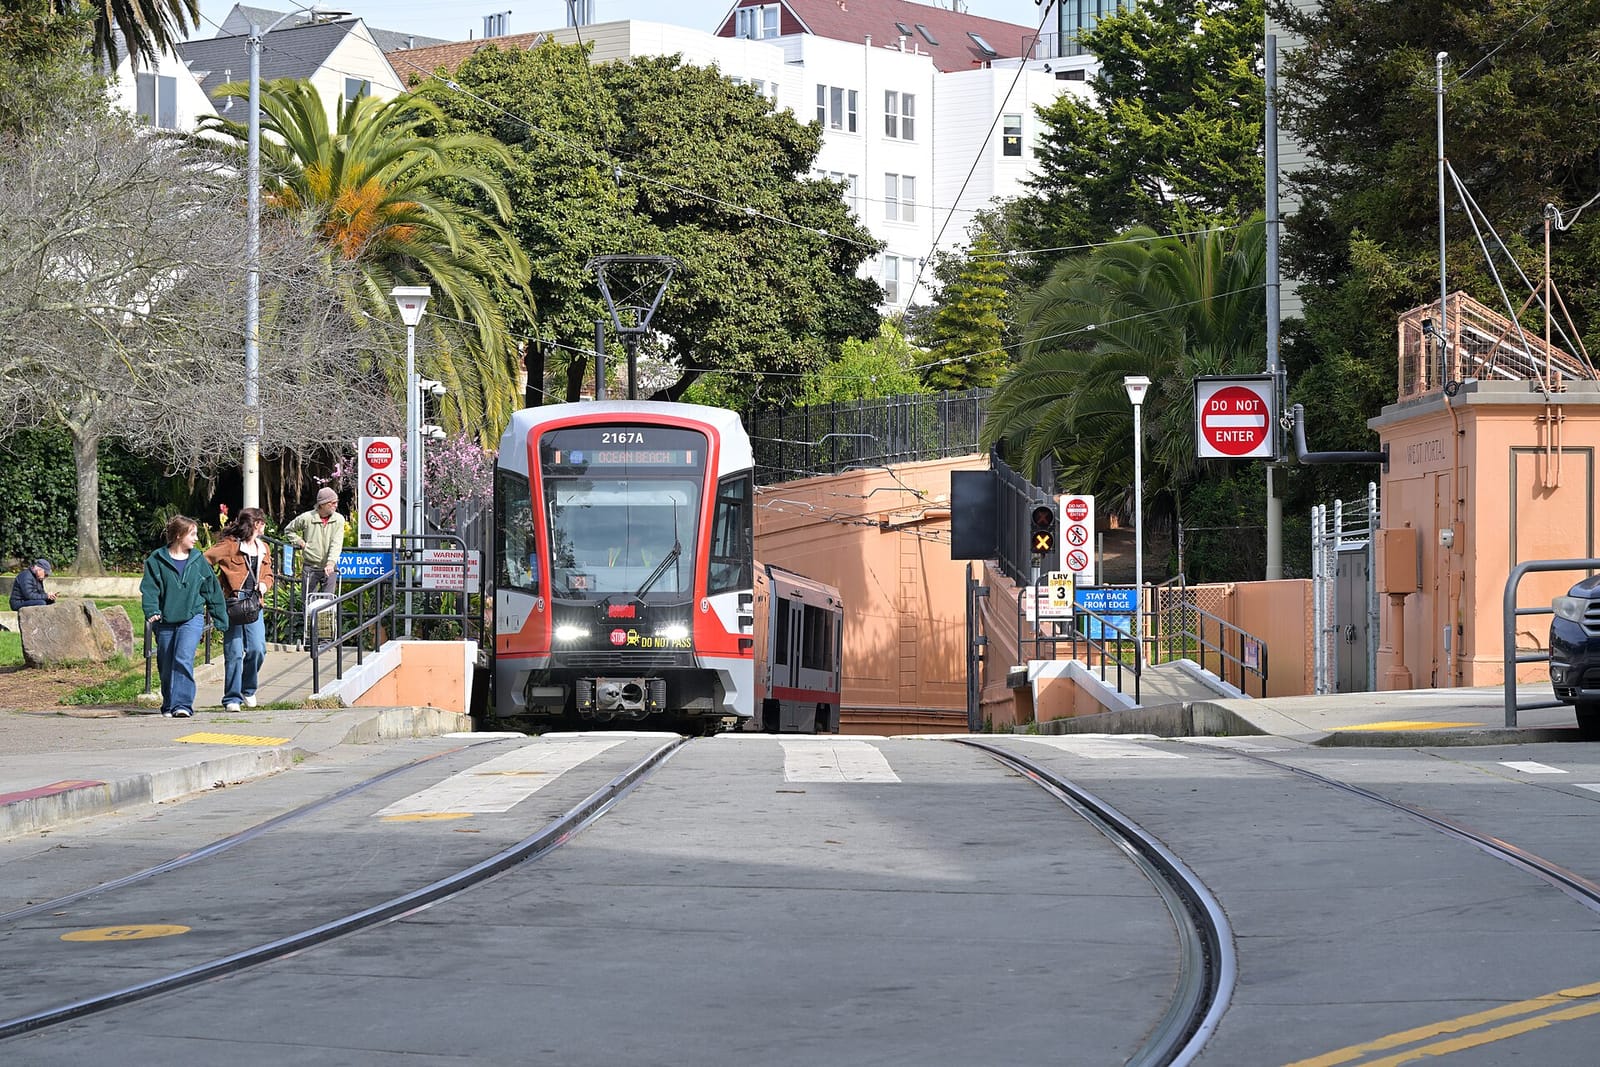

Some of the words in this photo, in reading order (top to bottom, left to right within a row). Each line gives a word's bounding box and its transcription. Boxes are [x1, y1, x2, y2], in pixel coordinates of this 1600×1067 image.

[1211, 400, 1227, 411] DO
[1236, 400, 1259, 411] NOT
[602, 432, 644, 444] 2167A
[1216, 430, 1254, 442] ENTER
[599, 451, 633, 463] OCEAN
[635, 451, 670, 463] BEACH
[356, 556, 382, 565] BACK
[359, 566, 385, 575] EDGE
[1056, 587, 1066, 599] 3
[611, 632, 626, 643] STOP
[641, 637, 652, 648] DO
[654, 637, 669, 648] NOT
[671, 638, 691, 648] PASS
